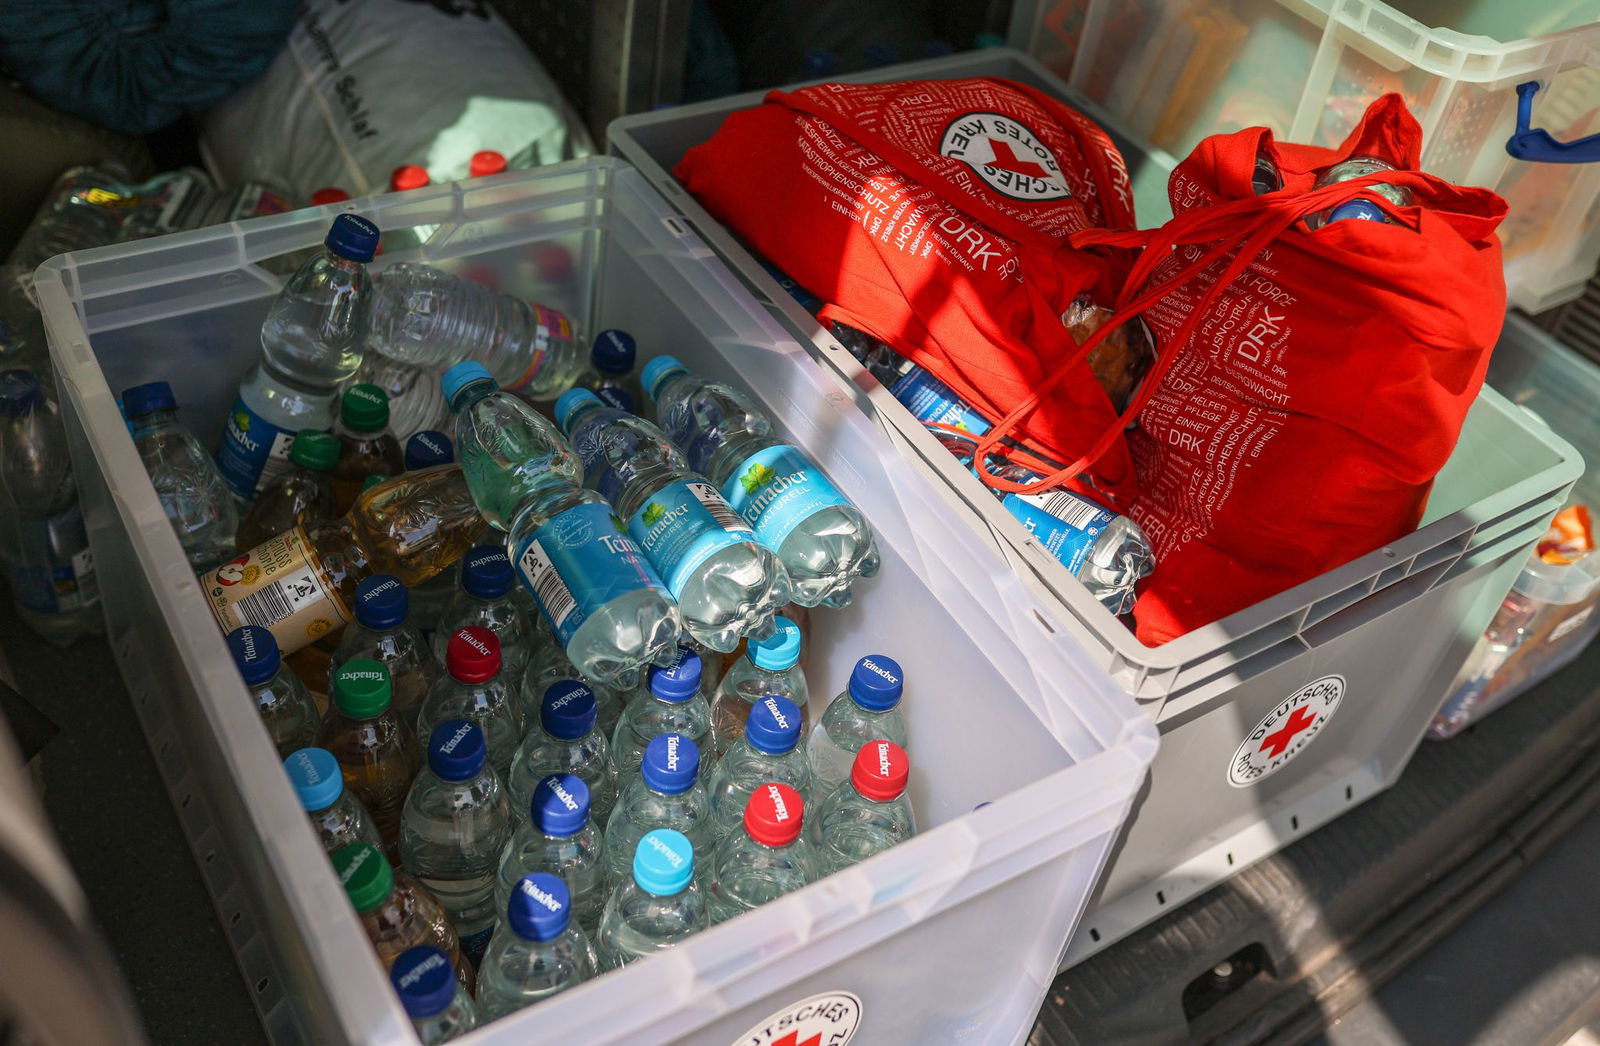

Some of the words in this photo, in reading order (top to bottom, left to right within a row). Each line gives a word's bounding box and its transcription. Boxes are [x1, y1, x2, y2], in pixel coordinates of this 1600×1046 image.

[946, 118, 988, 158] KREU
[994, 119, 1060, 172] ROTES
[868, 215, 883, 237] DRK
[931, 231, 951, 249] HENRY
[950, 247, 974, 272] DUNANT
[939, 216, 1003, 272] DRK
[1248, 277, 1298, 308] FORCE
[1201, 296, 1233, 337] PFLEGE
[1223, 334, 1238, 363] MEDICAL
[1236, 305, 1286, 363] DRK
[1171, 377, 1199, 395] DRK
[1232, 358, 1289, 390] UNPARTEILICHKEIT
[1271, 364, 1290, 379] DRK
[1148, 399, 1181, 416] PFLEGE
[1184, 404, 1224, 424] PFLEGE
[1190, 394, 1228, 414] HELFER
[1175, 415, 1212, 435] EINHEIT
[1168, 428, 1206, 456] DRK
[1251, 426, 1280, 459] EINHEIT
[740, 470, 809, 527] Teinacher
[757, 484, 811, 532] NATURELL
[641, 503, 689, 551] Teinacher
[653, 516, 690, 556] NATURELL
[470, 552, 508, 569] Teinacher
[363, 579, 400, 602] Teinacher
[244, 628, 257, 663] Teinacher
[457, 629, 491, 657] Teinacher
[340, 671, 386, 682] Teinacher
[862, 658, 899, 684] Teinacher
[552, 687, 591, 711] Teinacher
[764, 697, 790, 730] Teinacher
[1251, 683, 1339, 741] DEUTSCHES
[438, 722, 473, 755] Teinacher
[667, 735, 680, 771] Teinacher
[877, 742, 892, 777] Teinacher
[1237, 752, 1266, 779] ROTES
[546, 776, 579, 811] Teinacher
[768, 784, 790, 823] Teinacher
